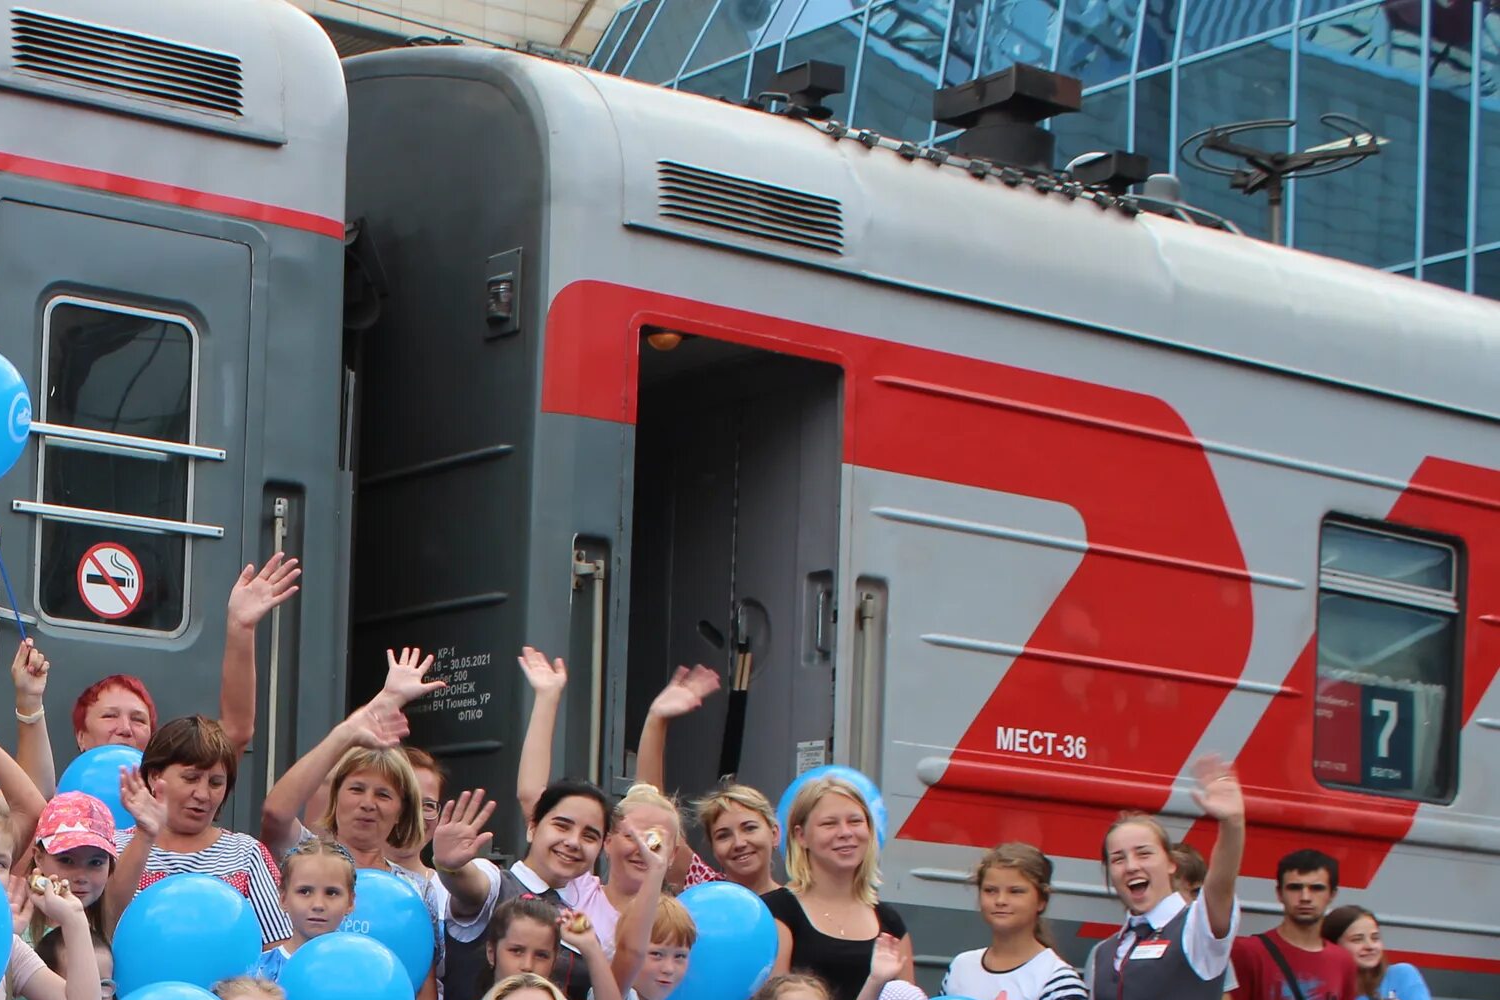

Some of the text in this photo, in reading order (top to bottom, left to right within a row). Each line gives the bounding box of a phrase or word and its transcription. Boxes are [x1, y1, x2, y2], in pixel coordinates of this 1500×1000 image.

[438, 647, 455, 659] КР-1
[450, 653, 491, 670] 30.05.2021
[454, 670, 468, 682] 500
[434, 681, 476, 698] ВОРОНЕЖ
[432, 699, 444, 711] ВЧ
[446, 697, 477, 709] Тюмень
[480, 693, 491, 705] УР
[458, 709, 483, 721] ФПКФ
[1371, 698, 1398, 758] 7
[996, 726, 1087, 759] МЕСТ-36
[345, 919, 370, 934] РСО
